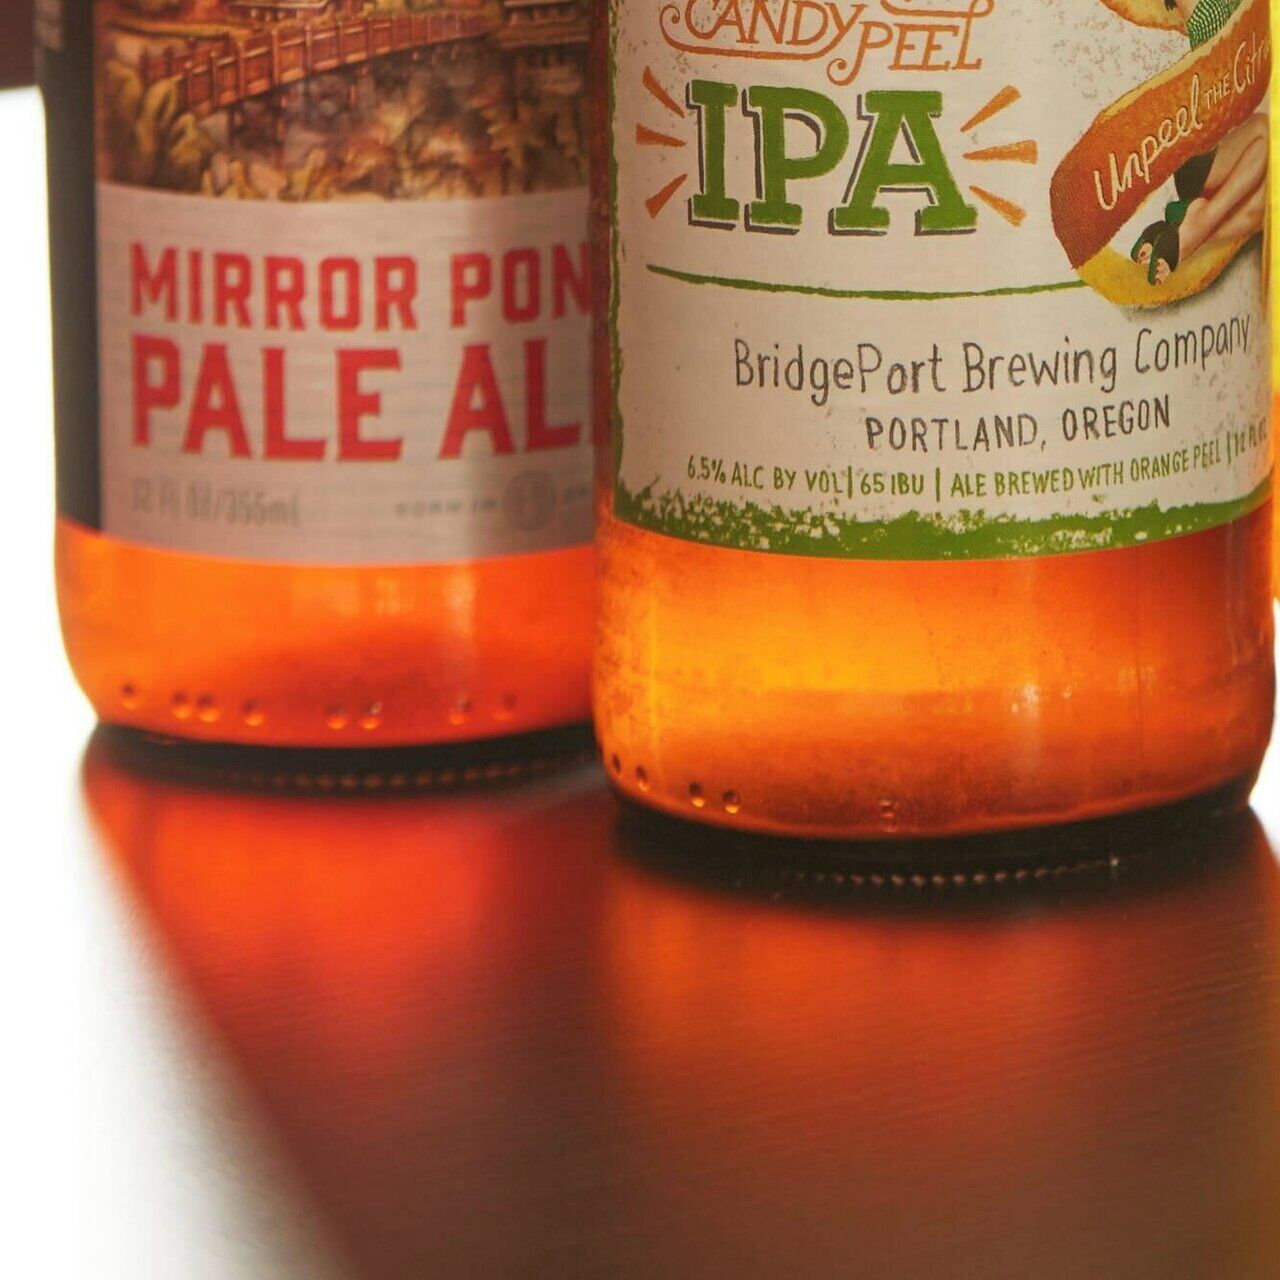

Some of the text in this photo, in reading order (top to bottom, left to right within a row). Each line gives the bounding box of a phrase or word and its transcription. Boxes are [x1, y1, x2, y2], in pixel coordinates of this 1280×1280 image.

[685, 78, 979, 236] IPA
[1093, 74, 1203, 211] Unpeel
[1205, 72, 1232, 110] THE
[130, 241, 591, 332] MIRROR PON
[130, 334, 582, 462] PALE AL
[734, 313, 1251, 407] BridgePort Brewing Company
[687, 455, 726, 484] 6.5%
[732, 461, 764, 489] ALC
[773, 466, 797, 489] BY
[805, 470, 844, 494] VOL
[860, 472, 885, 496] 65
[891, 472, 924, 495] IBU
[950, 473, 987, 498] ALE
[994, 467, 1074, 497] BREWED
[1078, 461, 1124, 490] WITH
[1130, 448, 1189, 482] ORANGE
[1193, 438, 1221, 470] PEEL
[866, 394, 1171, 453] PORTLAND, OREGON
